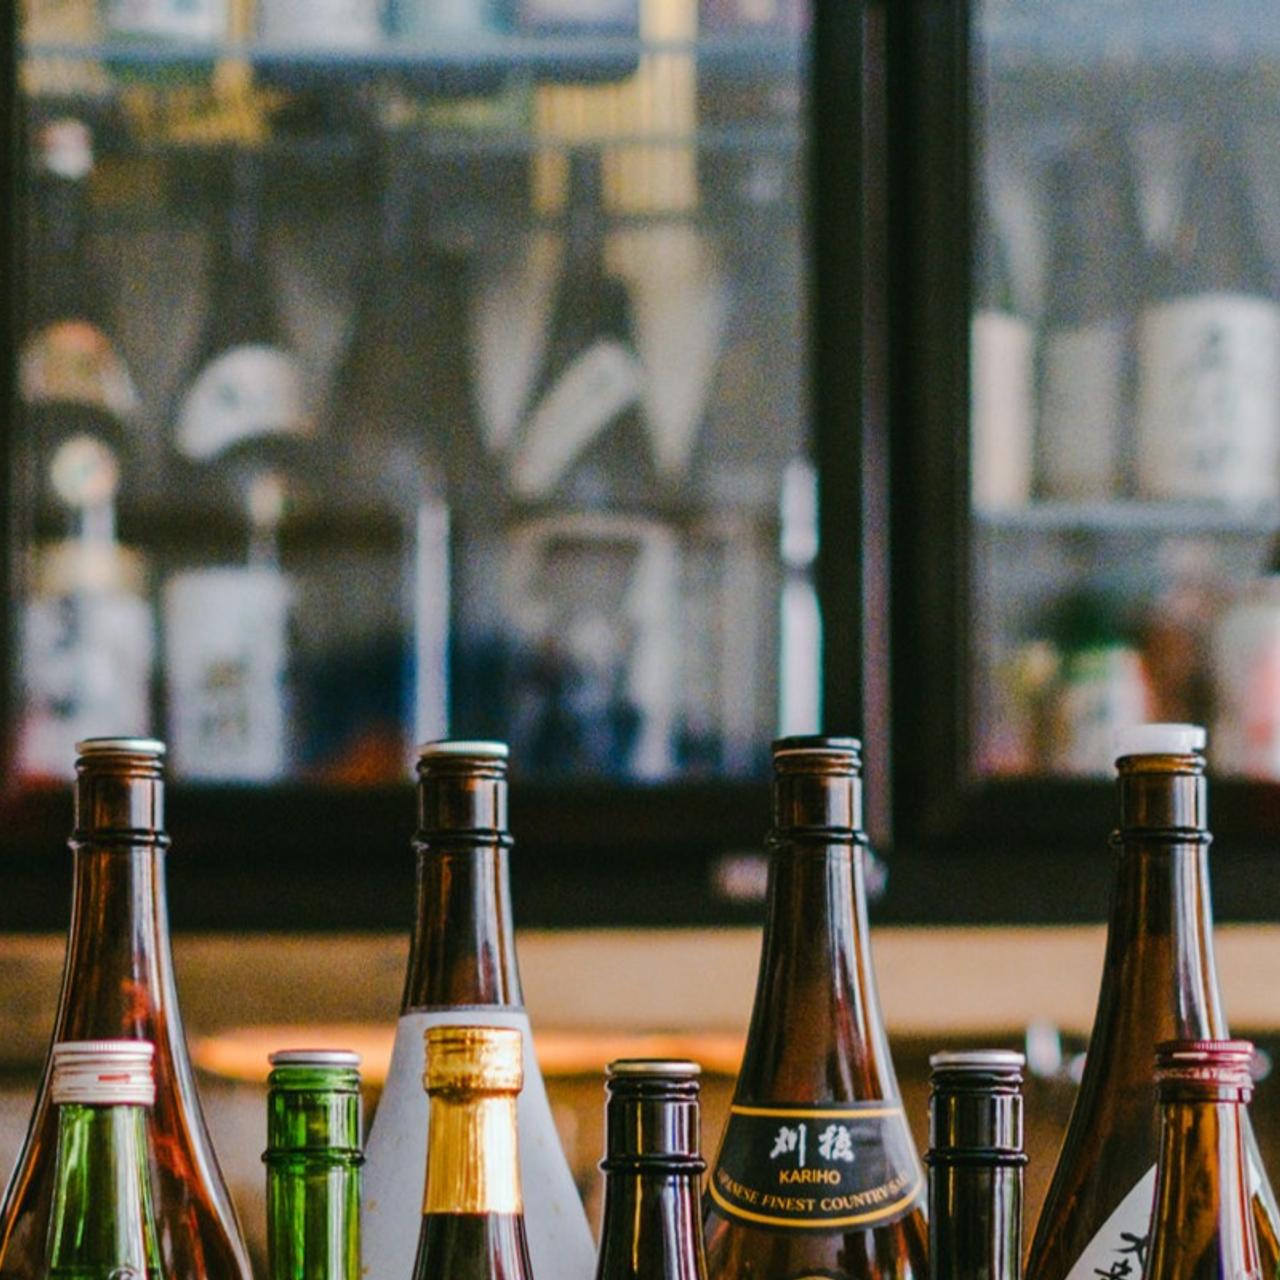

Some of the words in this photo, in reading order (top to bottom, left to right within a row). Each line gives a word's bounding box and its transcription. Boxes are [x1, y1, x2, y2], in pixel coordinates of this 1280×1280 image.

[779, 1170, 842, 1185] KARIHO
[761, 1195, 817, 1212] FINEST
[820, 1182, 889, 1211] COUNTRY
